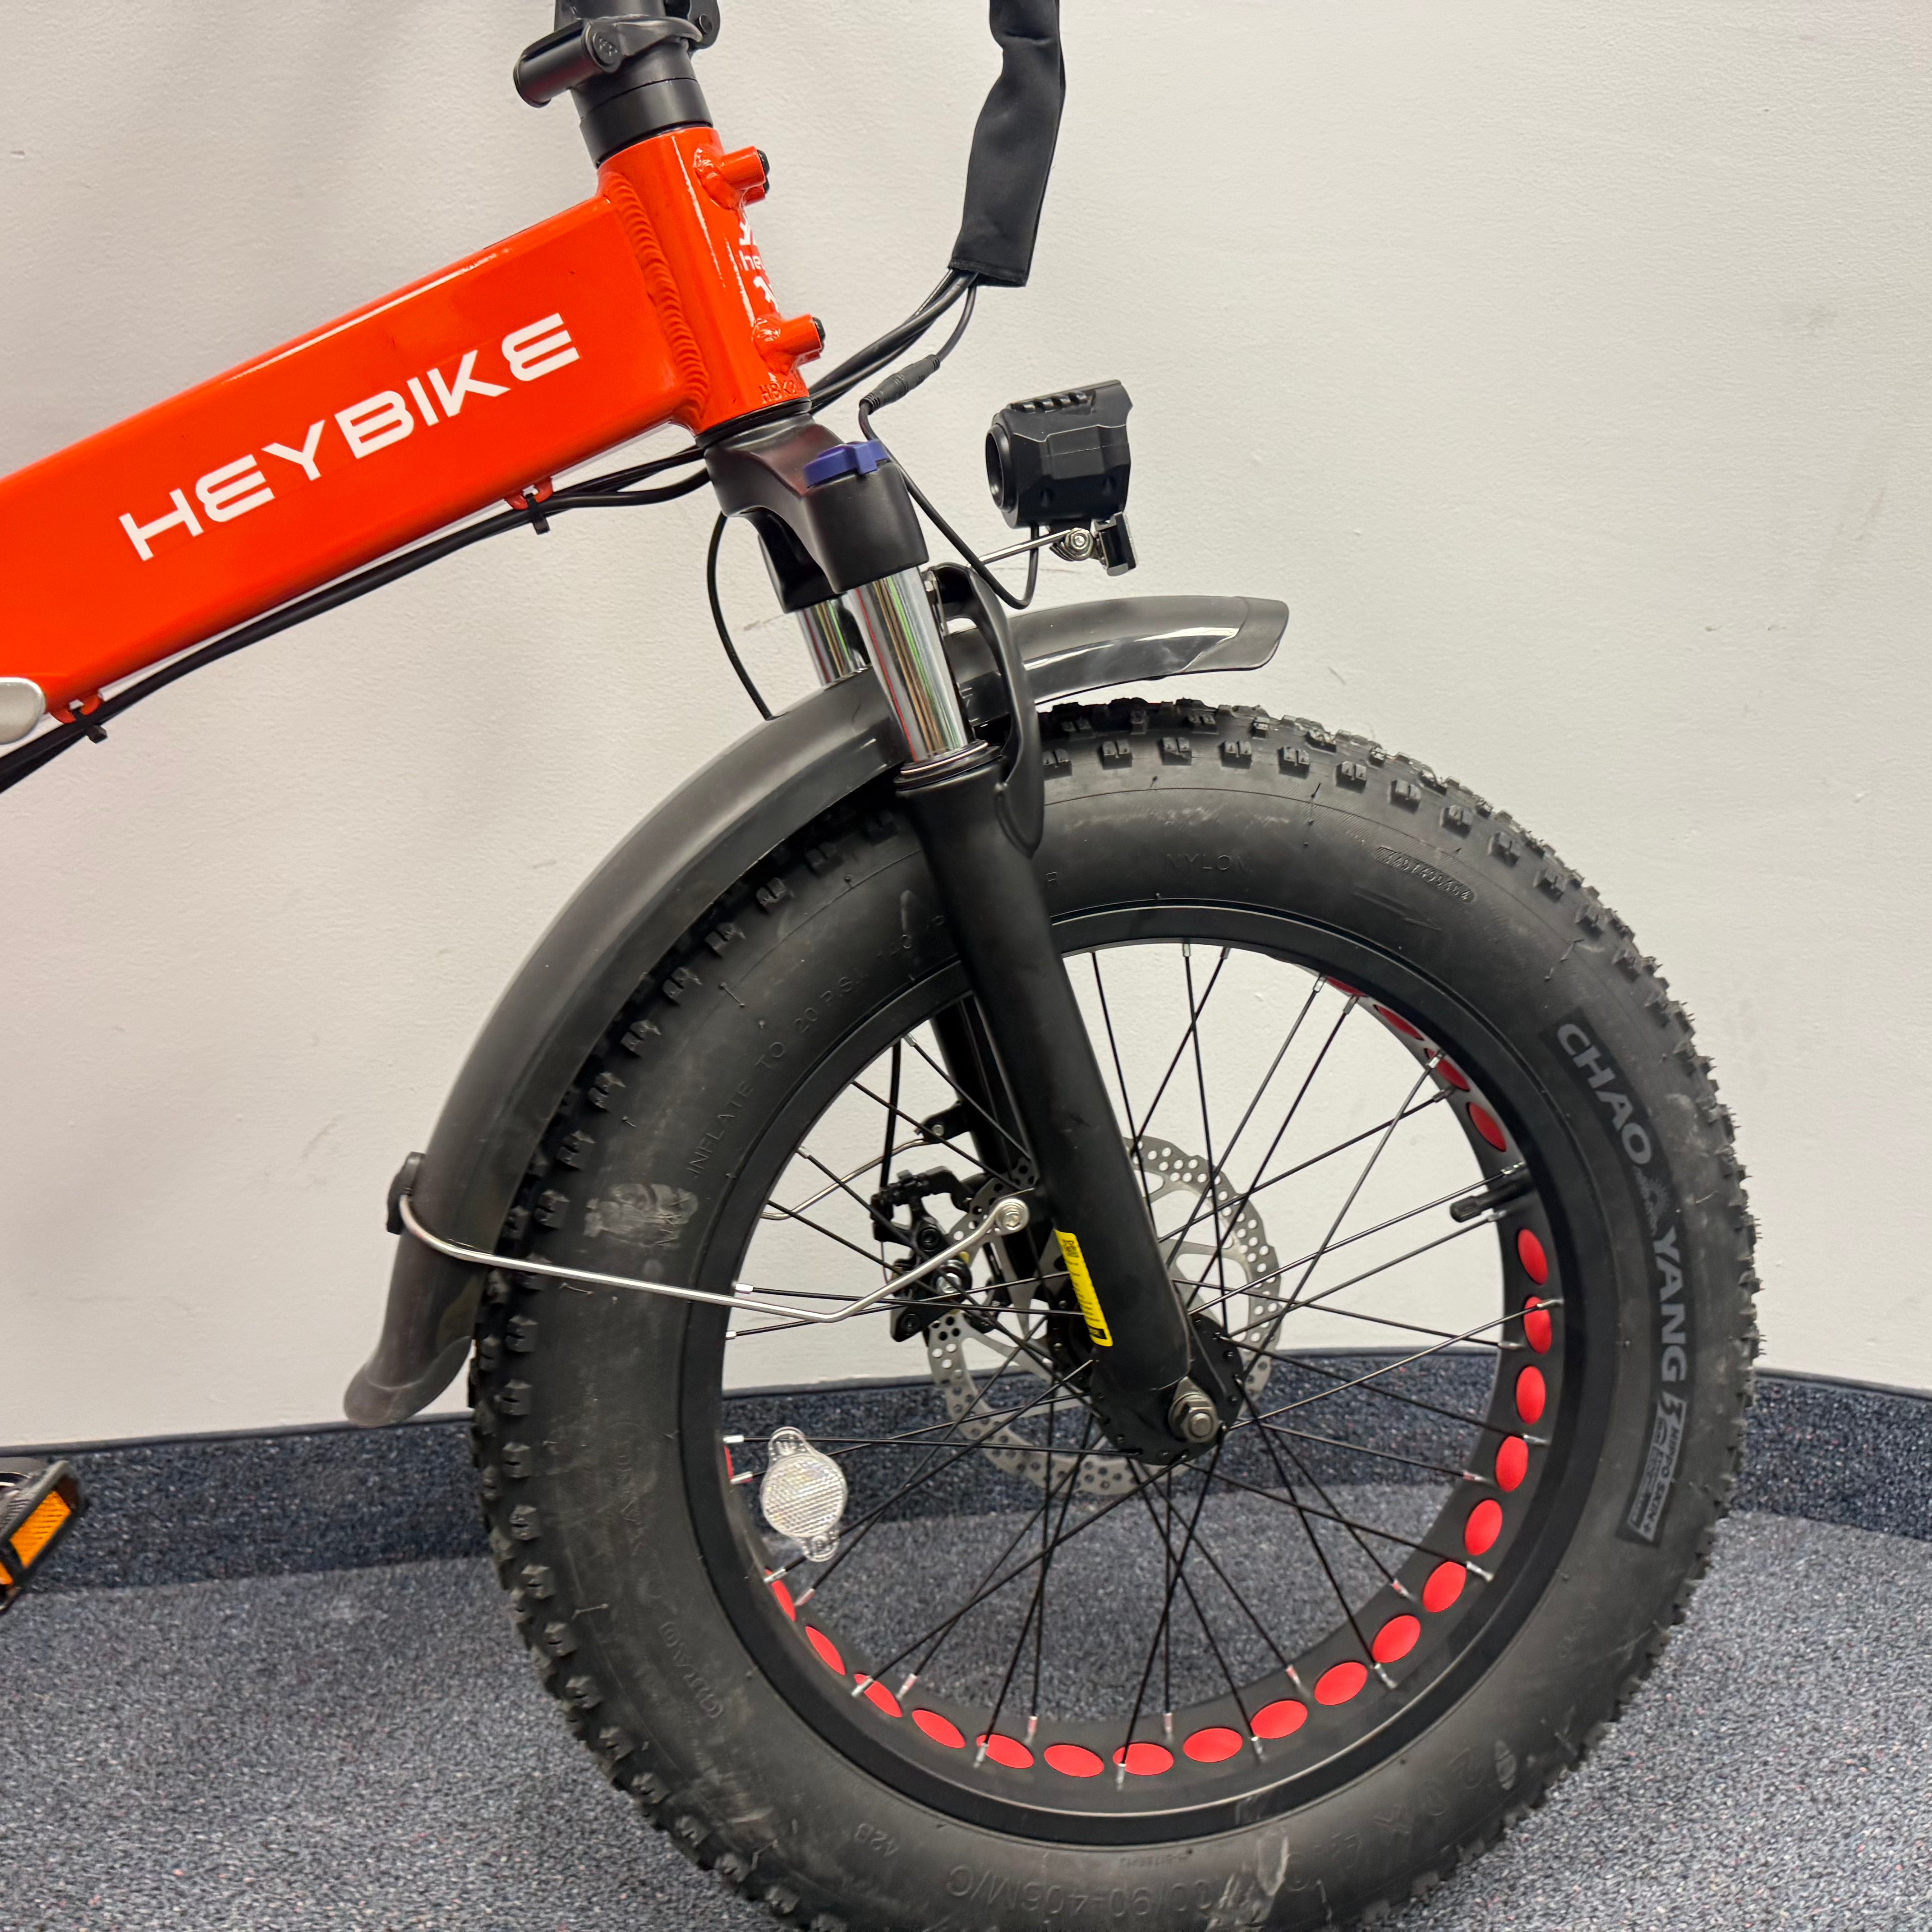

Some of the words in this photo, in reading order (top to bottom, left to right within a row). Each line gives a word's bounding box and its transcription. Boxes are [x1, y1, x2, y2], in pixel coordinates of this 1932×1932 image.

[119, 312, 580, 561] HEYBIKE
[685, 1078, 754, 1176] INFLATE
[754, 1037, 789, 1076] TO
[1557, 1023, 1651, 1165] CHAO
[1652, 1226, 1687, 1383] YANG
